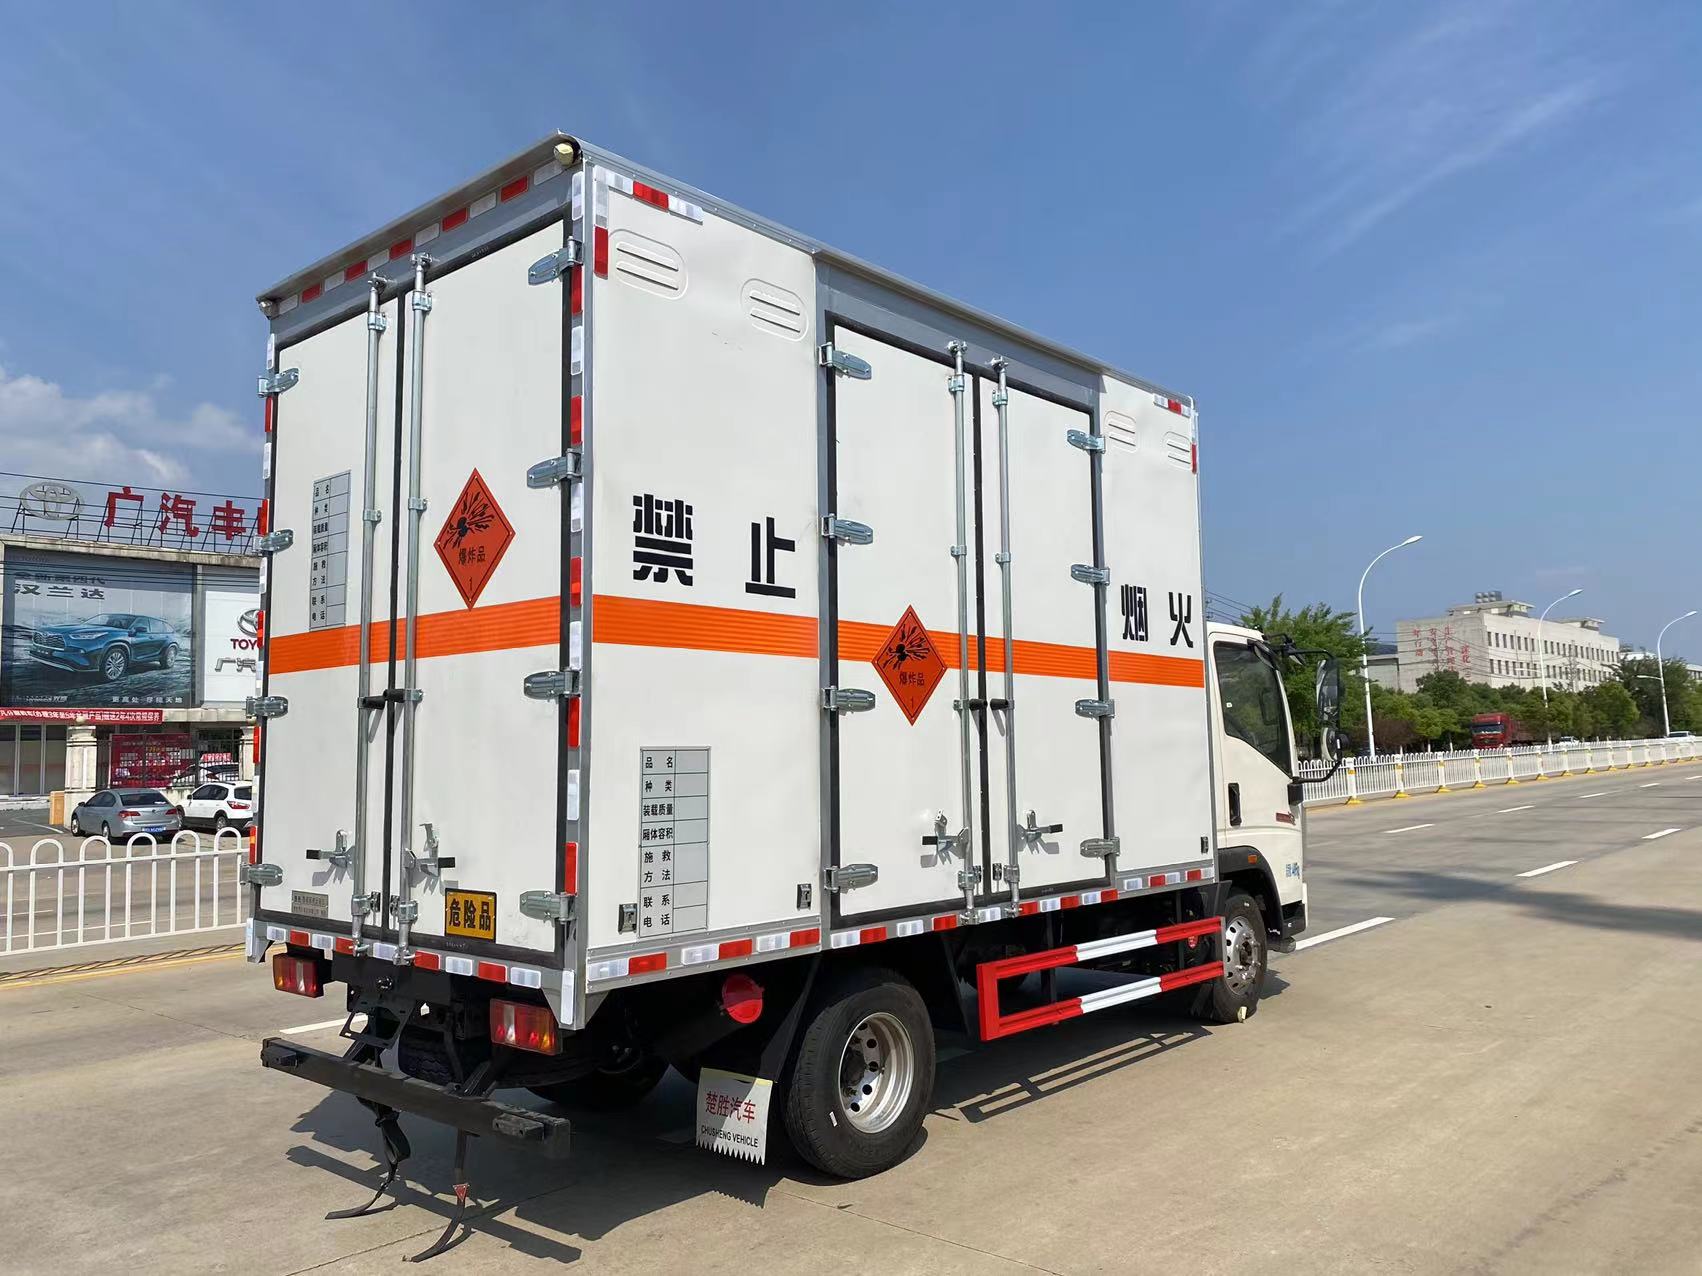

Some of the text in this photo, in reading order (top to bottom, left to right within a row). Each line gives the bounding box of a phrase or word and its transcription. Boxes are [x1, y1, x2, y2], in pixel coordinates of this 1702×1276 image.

[104, 486, 259, 540] 广汽丰
[458, 547, 486, 566] 爆炸品
[633, 493, 1194, 648] 禁止 烟火
[13, 584, 105, 600] 汉兰达
[899, 671, 925, 687] 爆炸品
[645, 756, 673, 769] 品名
[645, 779, 673, 793] 种类
[643, 803, 674, 817] 装载质量
[642, 827, 674, 841] 厢体容积
[644, 849, 672, 864] 施救
[643, 868, 671, 883] 方法
[643, 893, 671, 908] 联系
[449, 898, 491, 931] 危险品
[643, 913, 671, 928] 电话
[705, 1090, 756, 1124] 楚胜汽车
[701, 1124, 759, 1148] CHUSHENG VEHICLE
